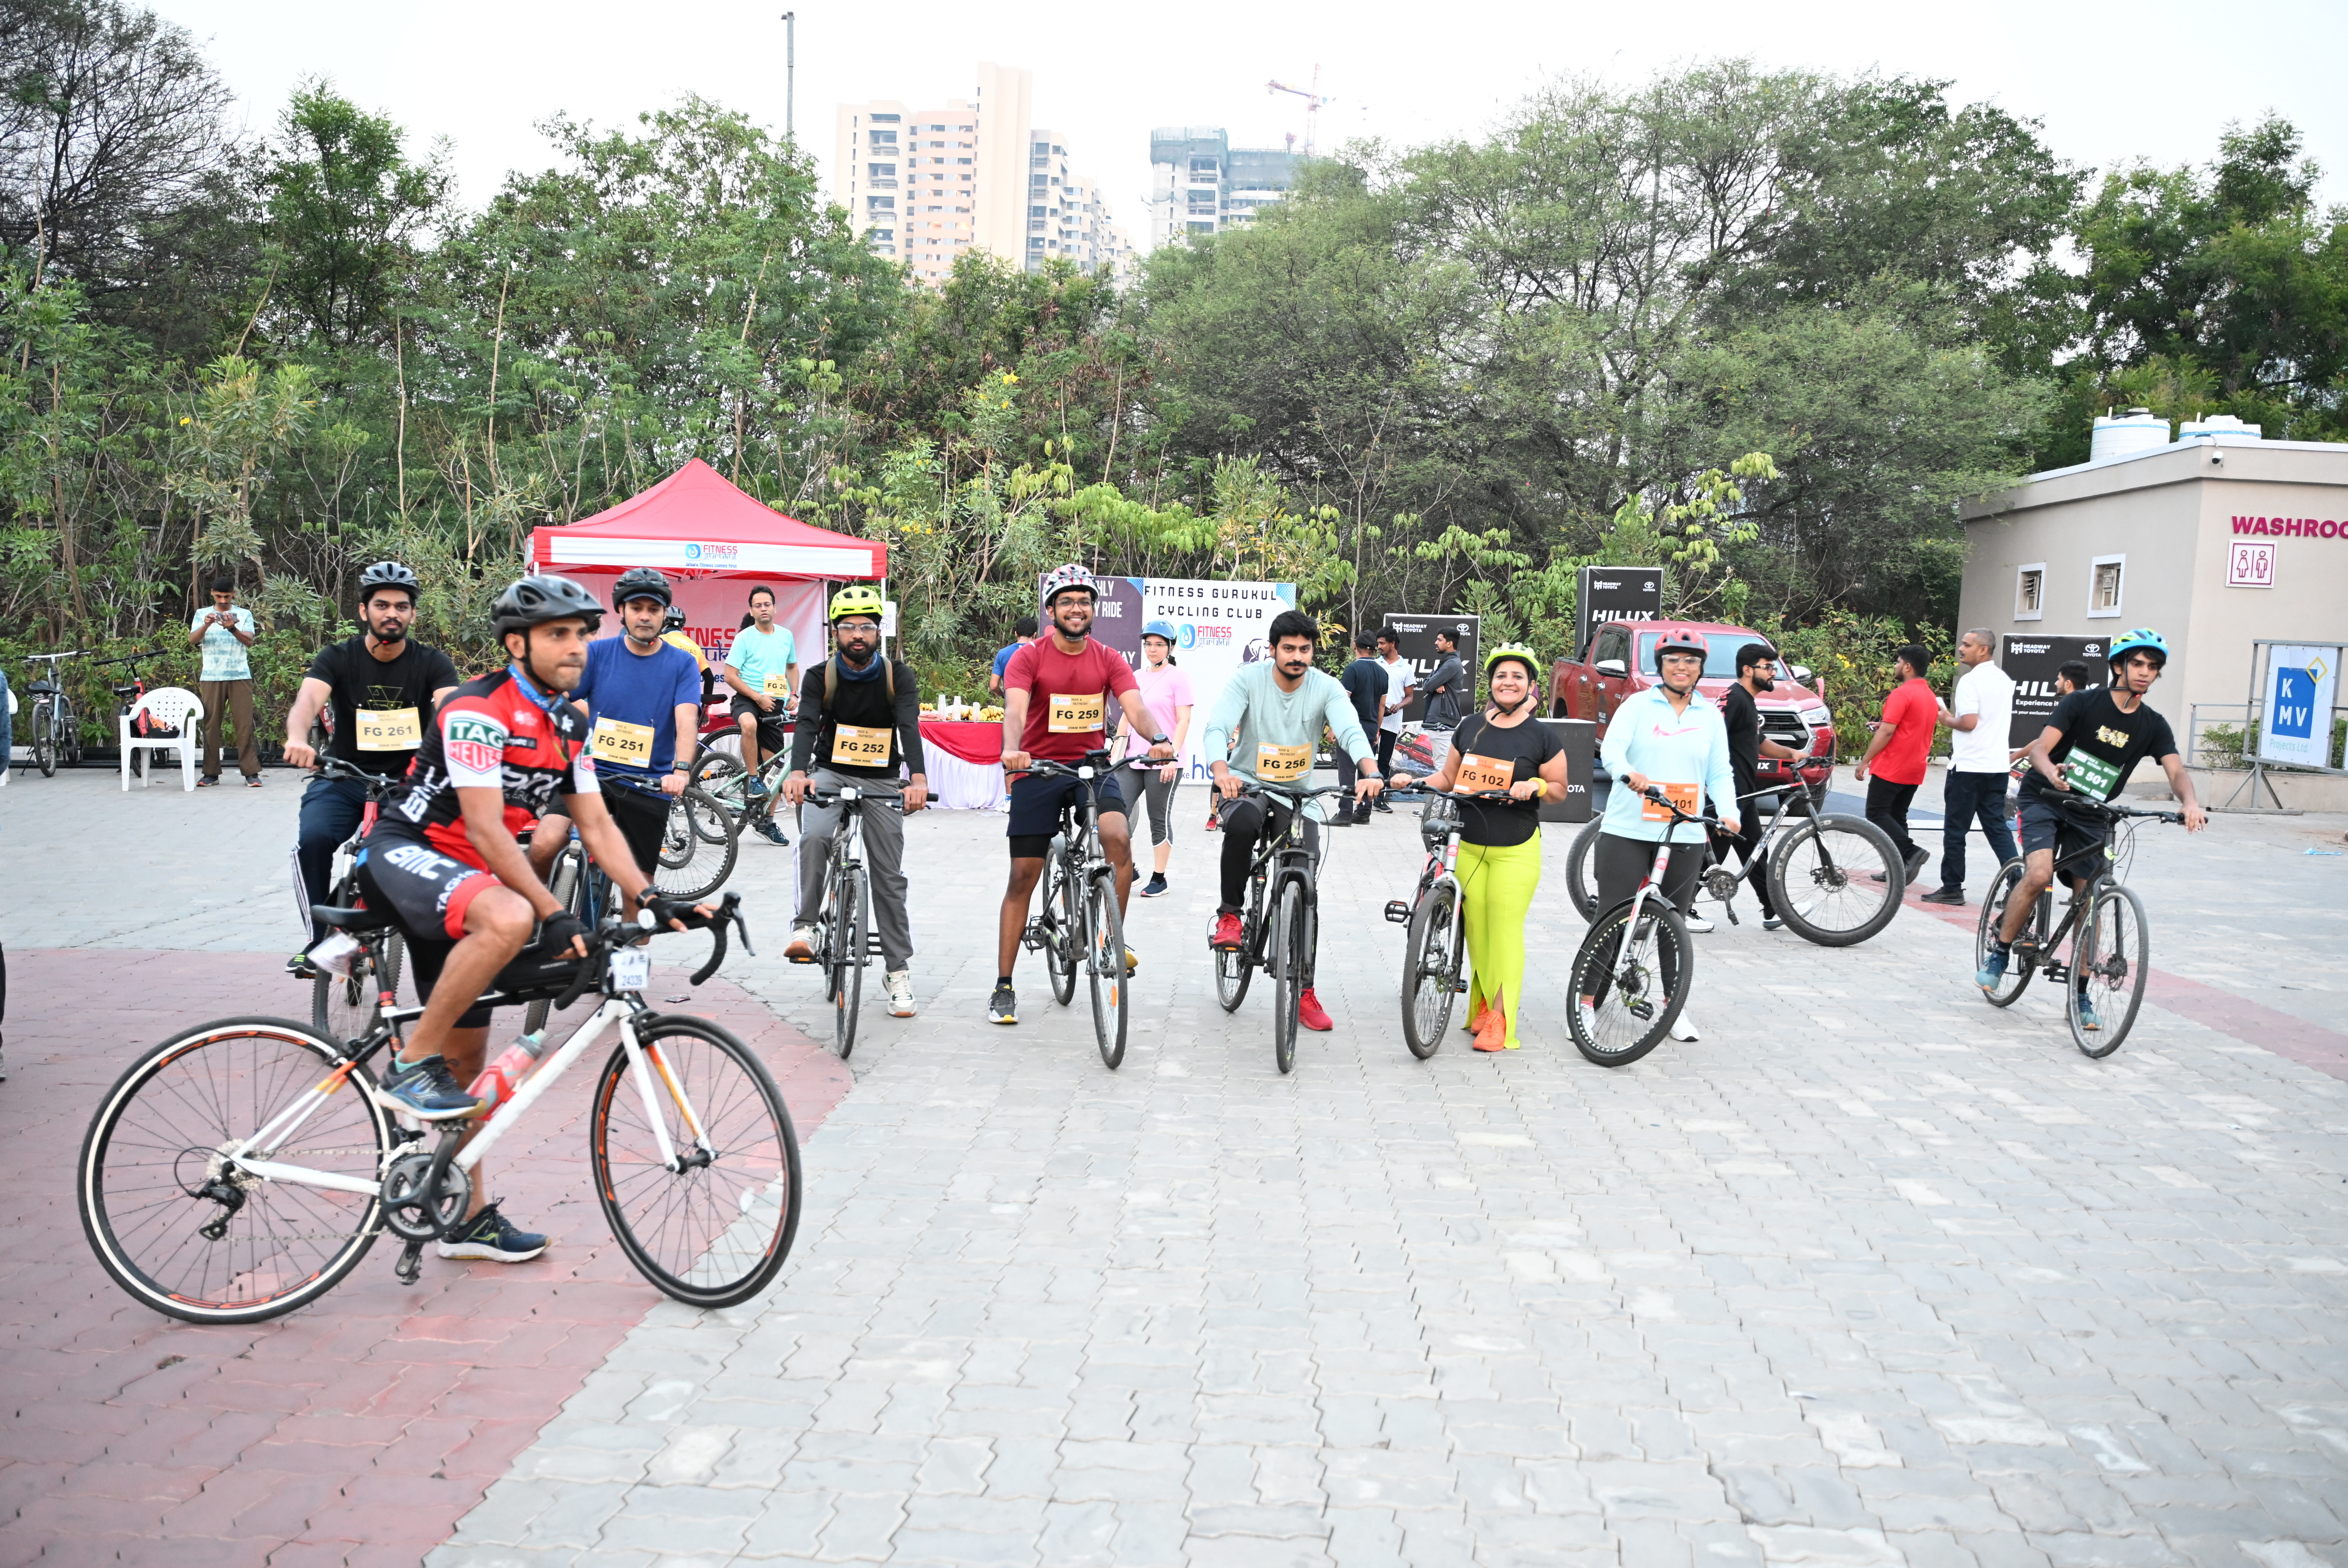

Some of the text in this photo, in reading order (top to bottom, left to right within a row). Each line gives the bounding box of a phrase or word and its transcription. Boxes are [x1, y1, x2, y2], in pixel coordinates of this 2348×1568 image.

[703, 545, 737, 554] FITNESS
[703, 551, 736, 561] gurukul
[1145, 586, 1276, 600] FITNESS GURUKUL
[1102, 601, 1123, 618] RIDE
[1158, 606, 1262, 619] CYCLING CLUB
[1592, 610, 1654, 622] HILUX
[1198, 626, 1232, 638] FITNESS
[1197, 634, 1230, 648] gurukul
[2282, 678, 2293, 698] K
[1057, 709, 1099, 719] FG 259
[364, 725, 412, 736] FG 261
[453, 722, 504, 747] TAG
[598, 735, 644, 752] FG 251
[841, 741, 884, 753] FG 252
[2270, 739, 2296, 751] Projects
[1264, 759, 1305, 769] FG 256
[1462, 770, 1504, 787] FG 102
[2085, 772, 2108, 788] 501
[1673, 800, 1692, 808] 101
[384, 845, 457, 880] BMC
[622, 975, 642, 986] 24339
